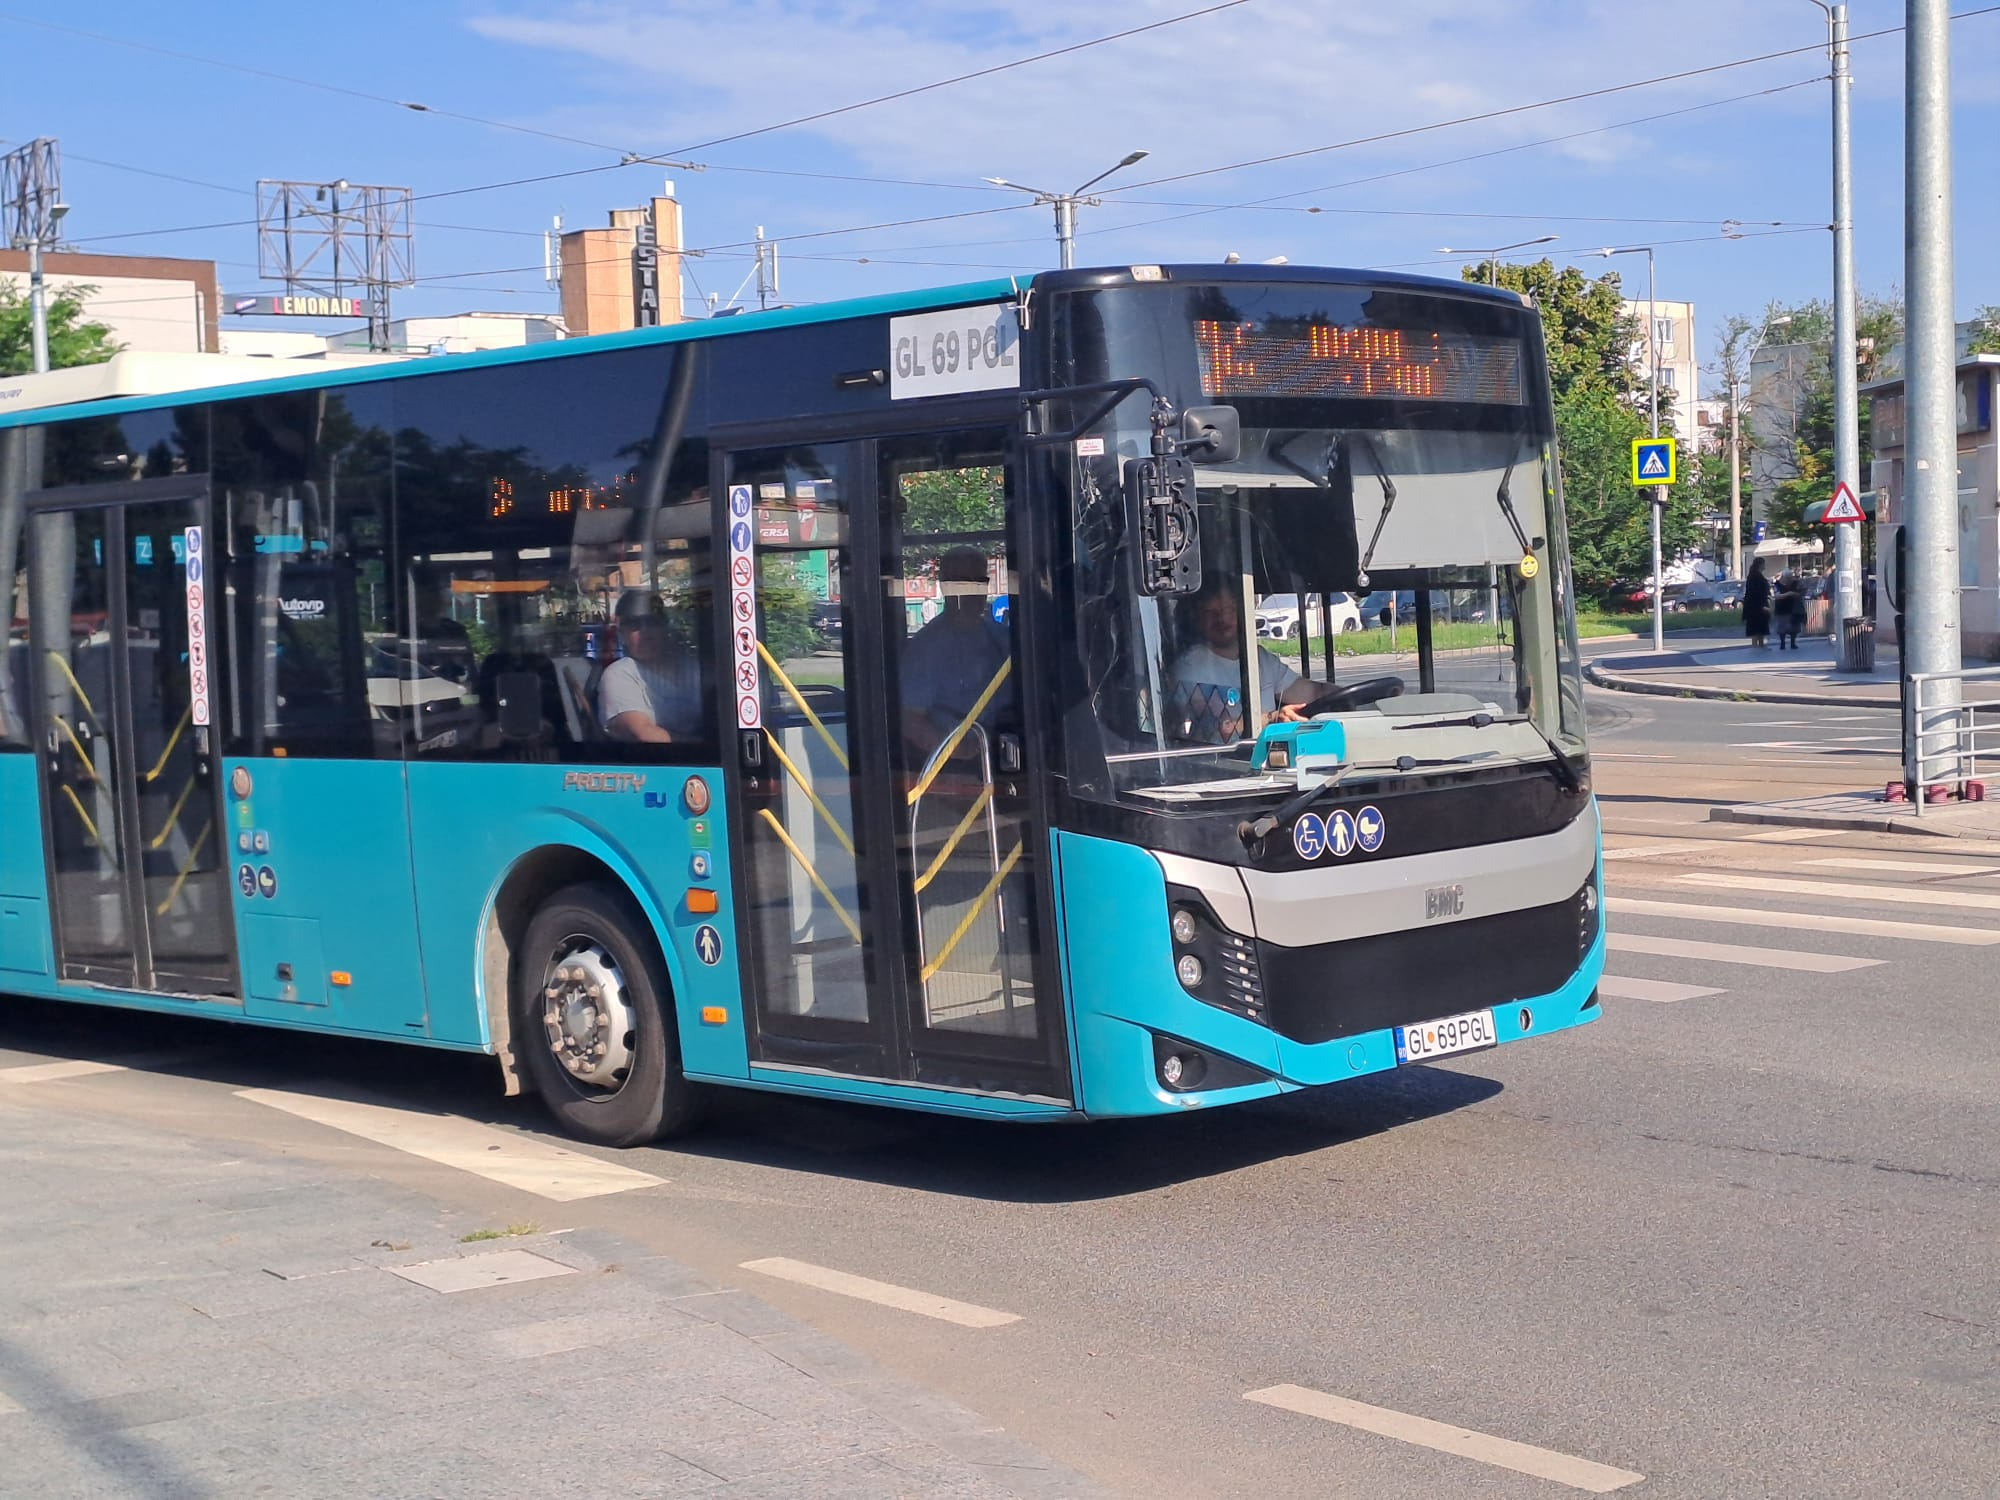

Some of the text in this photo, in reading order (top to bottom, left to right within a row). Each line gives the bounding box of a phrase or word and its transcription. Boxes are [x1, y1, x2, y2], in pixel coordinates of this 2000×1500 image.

[273, 297, 361, 316] LEMONADE
[896, 324, 1014, 378] GL 69 PGL
[563, 772, 646, 794] PROCITY
[1425, 884, 1464, 919] BMC
[1409, 1028, 1432, 1054] GL
